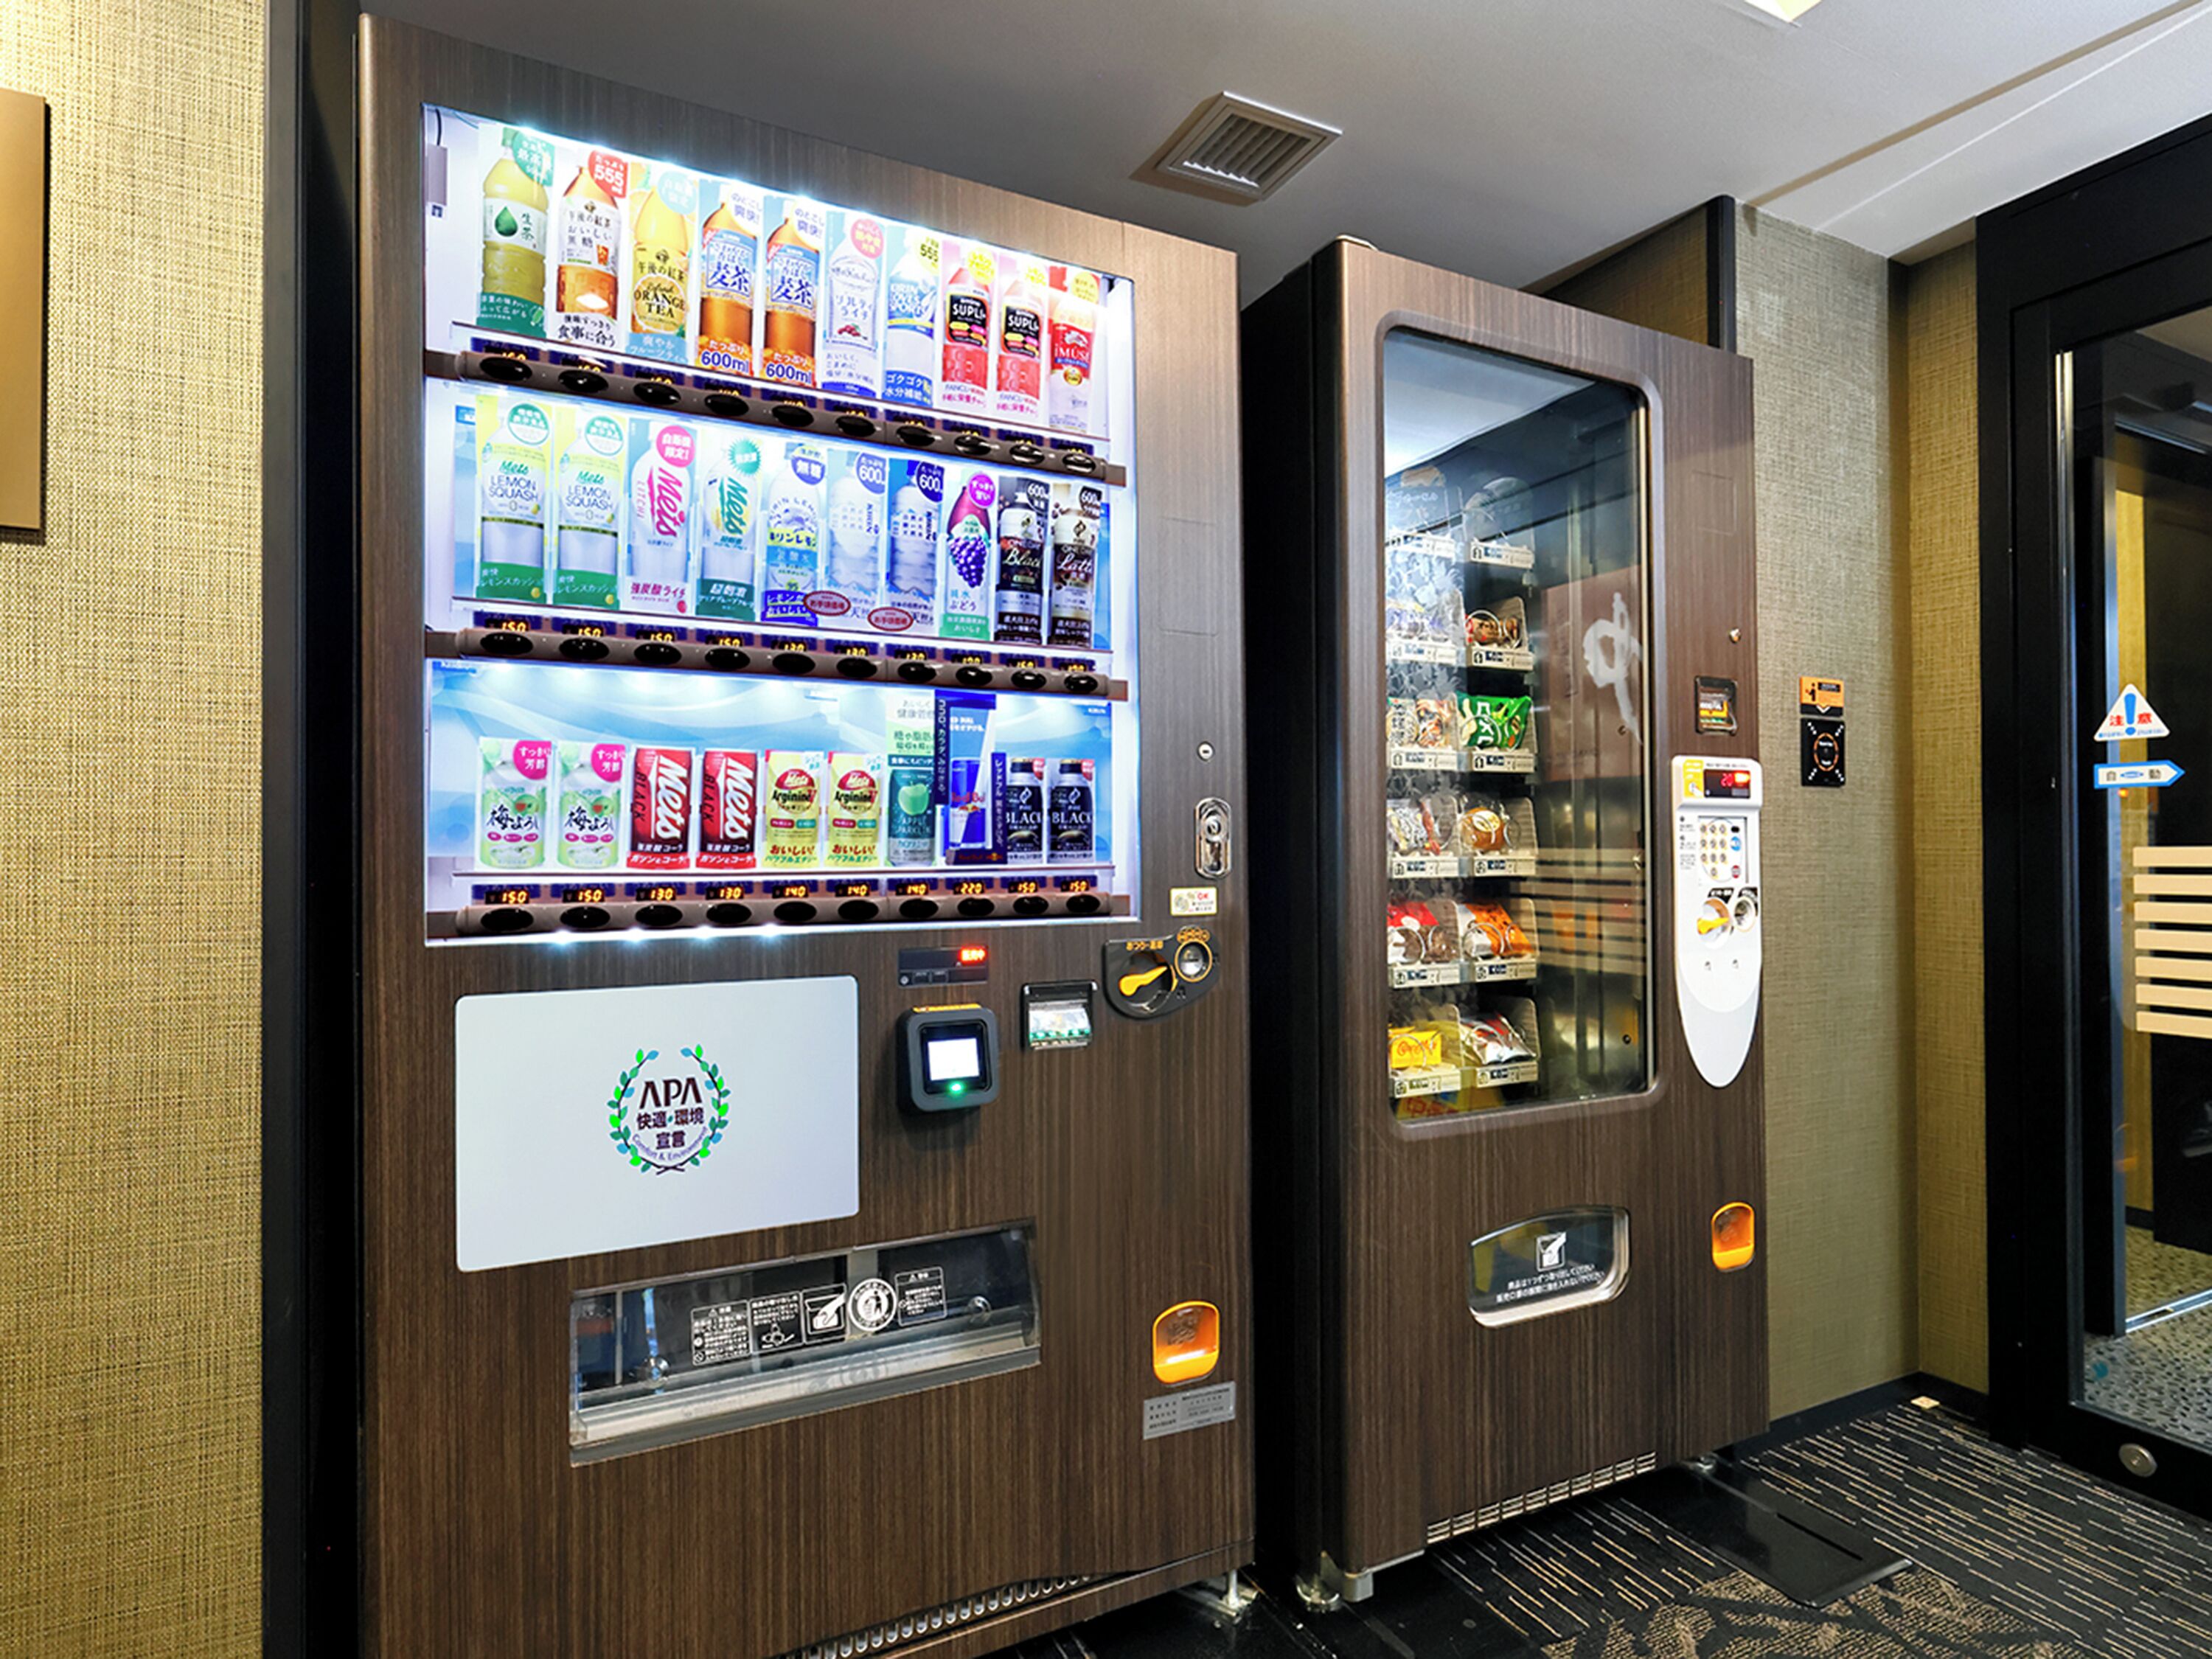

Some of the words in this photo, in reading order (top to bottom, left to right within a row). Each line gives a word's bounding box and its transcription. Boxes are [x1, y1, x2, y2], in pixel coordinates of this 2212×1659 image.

[594, 164, 624, 186] 555
[521, 212, 534, 241] 生茶
[709, 261, 750, 293] 麦茶
[773, 275, 813, 305] 麦茶
[633, 288, 686, 311] ORANGE
[646, 302, 675, 318] TEA
[559, 324, 616, 347] 食事に合う
[701, 351, 750, 373] 600ml
[765, 363, 812, 385] 600ml
[887, 374, 923, 388] ゴクゴク
[490, 475, 537, 492] LEMON
[488, 486, 540, 503] SQUASH
[568, 484, 611, 501] LEMON
[566, 495, 613, 511] SQUASH
[655, 467, 686, 538] Mets
[724, 476, 749, 535] Mets
[630, 581, 686, 599] 強炭酸ライチ
[949, 599, 978, 613] ぶどう
[518, 746, 552, 759] すっきり
[596, 749, 626, 761] すっきり
[634, 771, 648, 823] BLACK
[655, 754, 689, 841] Mets
[703, 773, 716, 824] BLACK
[724, 757, 754, 839] Mets
[771, 790, 811, 805] Arginine
[834, 790, 872, 804] Arginine
[769, 844, 815, 856] おいしい!
[832, 844, 877, 855] おいしい!
[578, 889, 602, 901] 150
[650, 888, 674, 900] 130
[720, 887, 742, 899] 130
[785, 886, 806, 897] 140
[847, 885, 868, 897] 140
[907, 883, 927, 895] 140
[960, 883, 982, 894] 220
[1017, 882, 1036, 894] 150
[1069, 881, 1088, 892] 150
[502, 891, 527, 902] 150
[639, 1077, 703, 1110] APA
[636, 1107, 704, 1131] 快適・環境
[655, 1130, 686, 1150] 宣言
